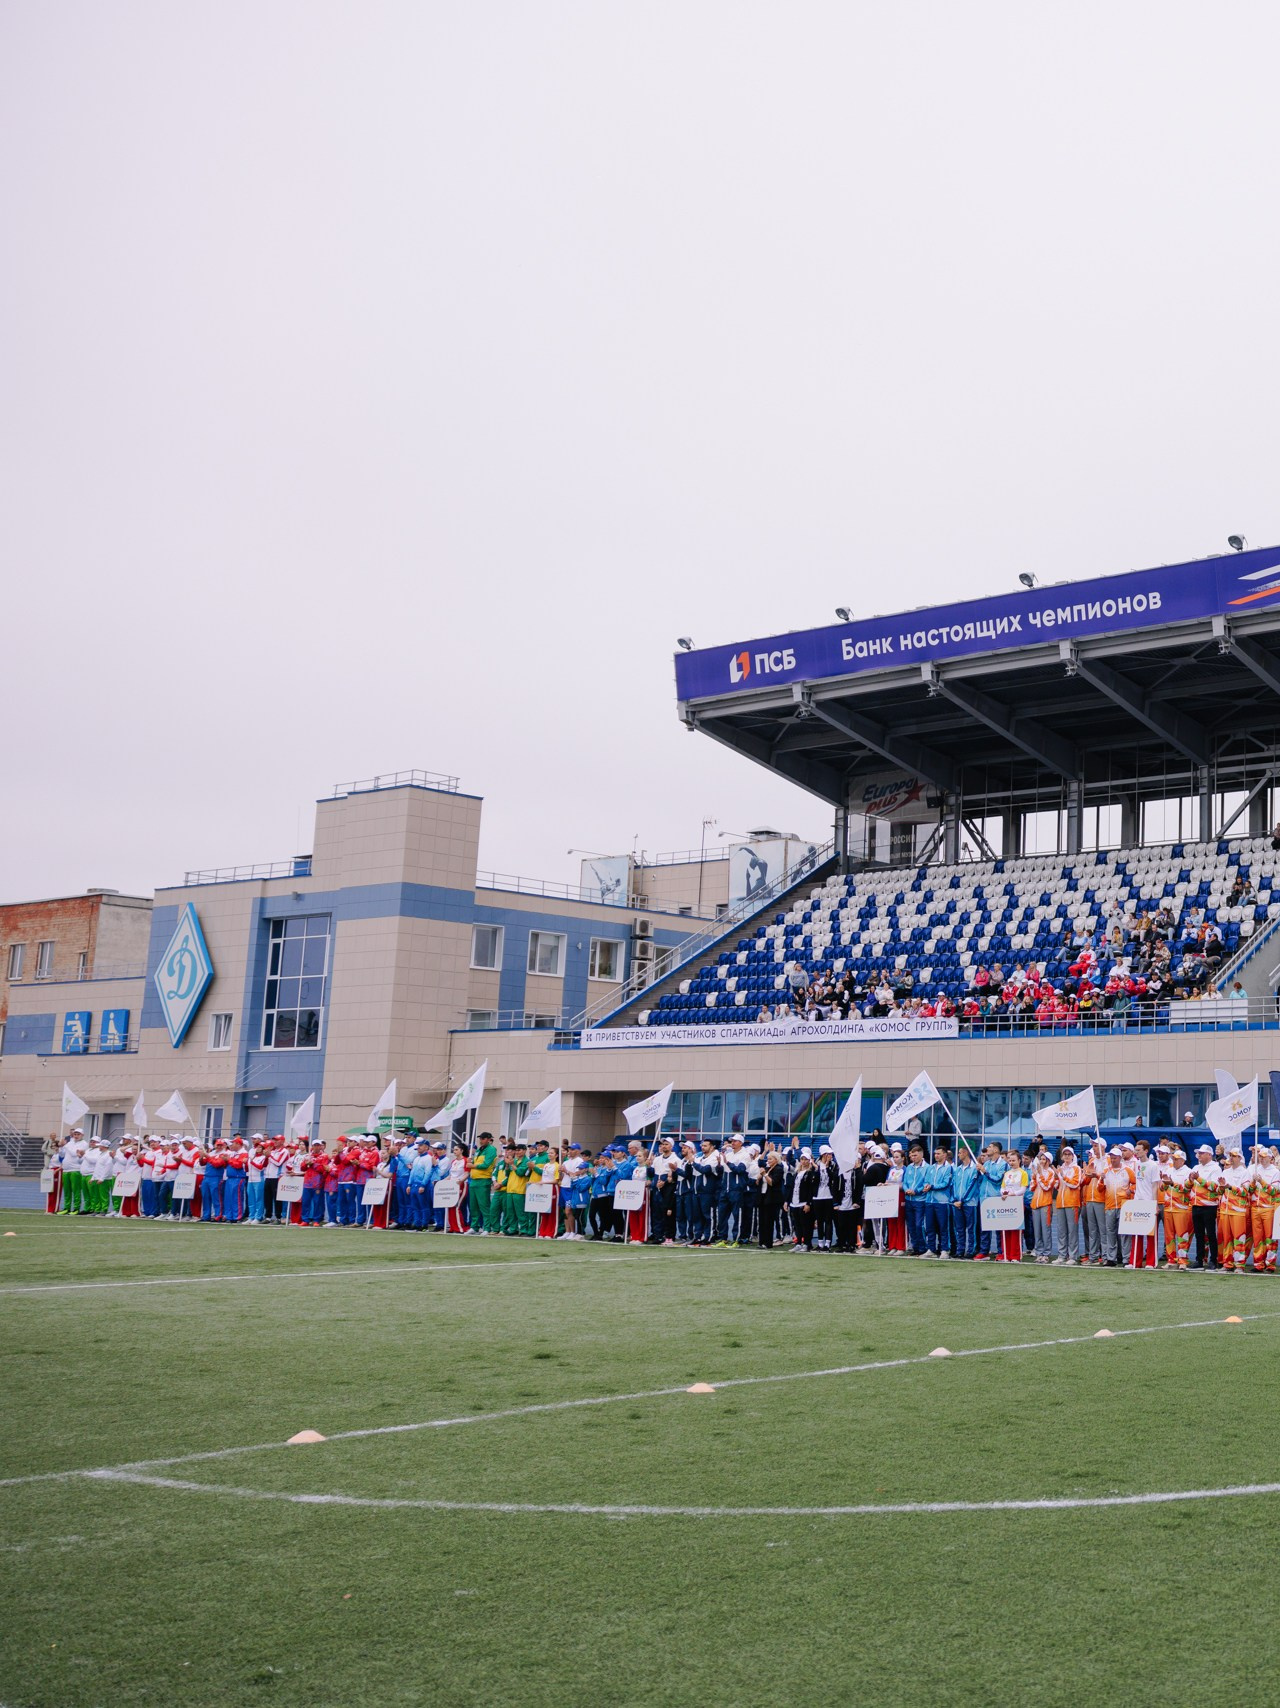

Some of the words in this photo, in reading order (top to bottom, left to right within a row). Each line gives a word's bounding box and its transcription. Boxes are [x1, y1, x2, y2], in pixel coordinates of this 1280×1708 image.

[842, 638, 895, 661] Банк
[899, 612, 1022, 651] настоящих
[1028, 591, 1162, 629] чемпионов
[755, 649, 797, 675] ПСБ
[862, 778, 914, 803] Europa
[596, 1030, 657, 1042] ПРИВЕТСТВУЕМ
[660, 1028, 717, 1041] УЧАСТНИКОВ
[790, 1023, 866, 1037] АГРОХОЛДИНГА
[869, 1020, 911, 1033] «КОМОС
[914, 1019, 953, 1032] ГРУПП»
